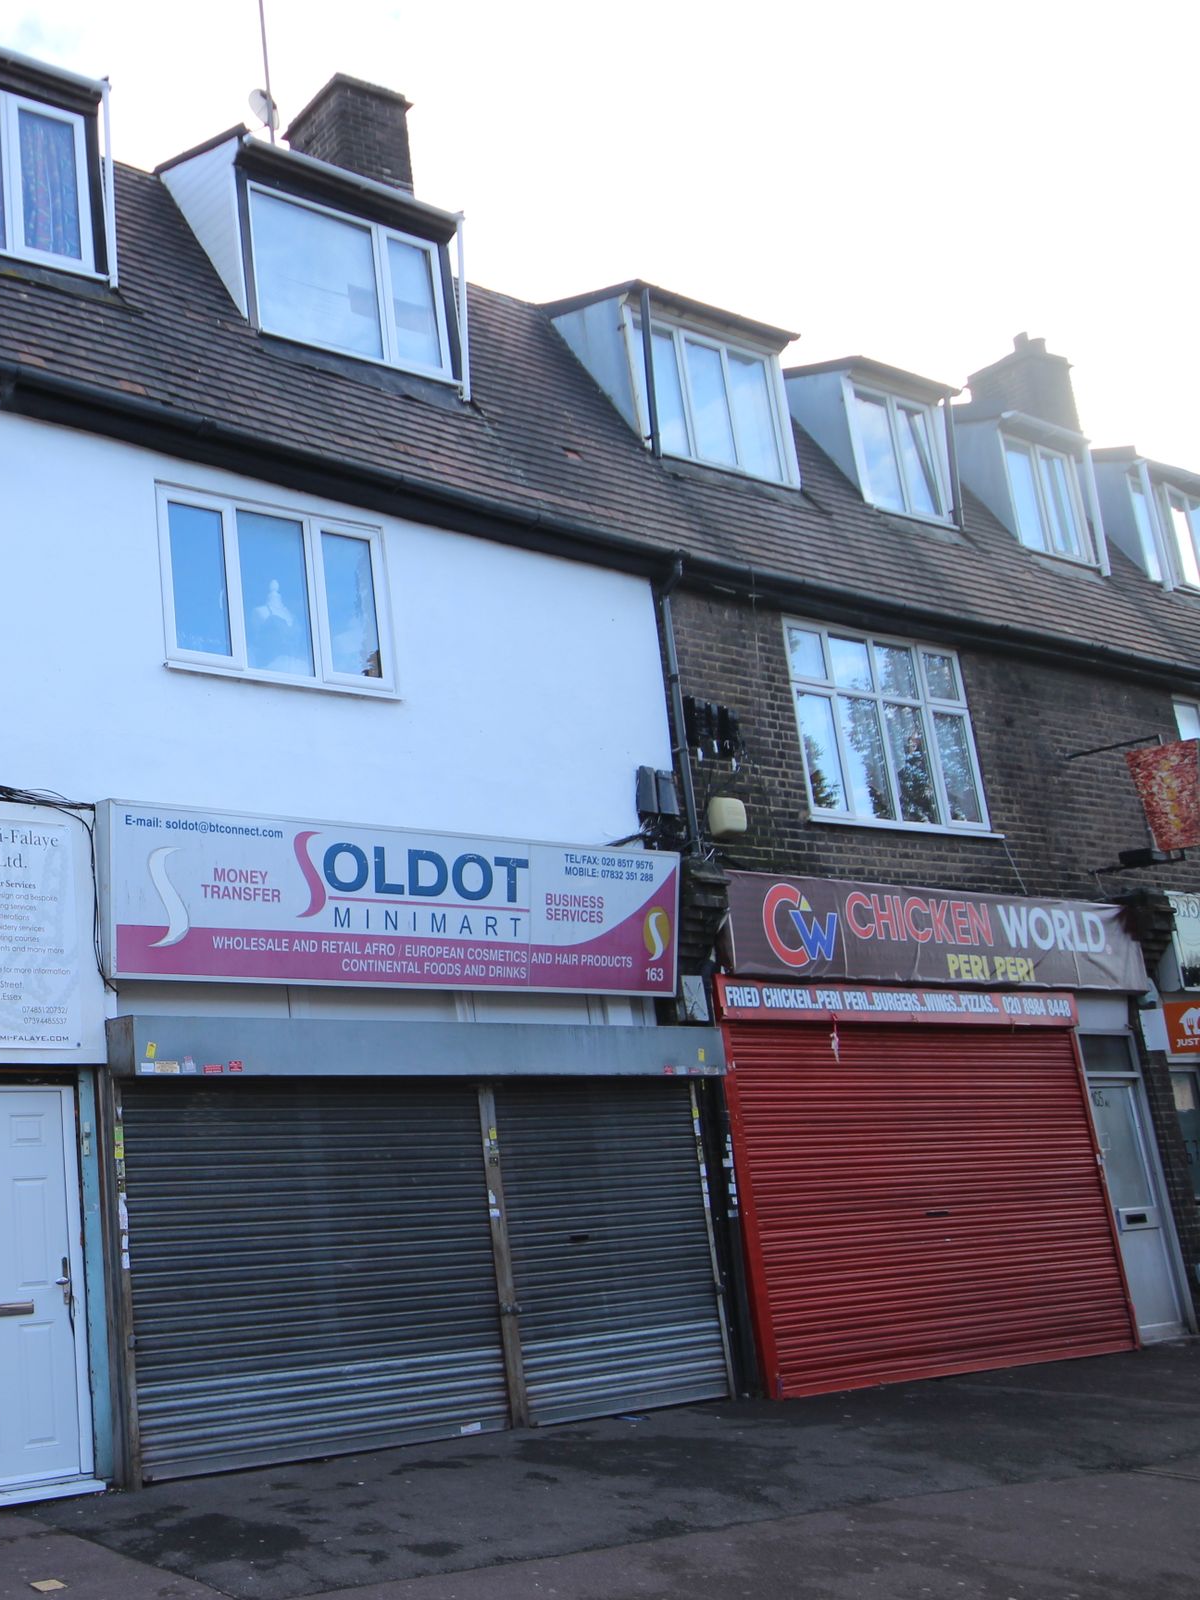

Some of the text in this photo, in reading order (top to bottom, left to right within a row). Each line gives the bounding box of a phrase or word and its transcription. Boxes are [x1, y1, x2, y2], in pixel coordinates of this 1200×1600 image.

[125, 814, 284, 839] E-mail: soldot@btconnect.com
[564, 853, 654, 871] TEL/FAX: 020 8517 9576
[213, 867, 269, 885] MONEY
[293, 830, 530, 918] SOLDOT
[564, 866, 654, 882] MOBILE: 07832 351 288
[5, 879, 36, 890] Services
[200, 884, 282, 903] TRANSFER
[545, 893, 605, 909] BUSINESS
[334, 906, 522, 938] MINIMART
[545, 908, 604, 924] SERVICES
[845, 891, 1106, 953] CHICKEN WORLD
[211, 935, 289, 952] WHOLESALE
[292, 939, 318, 953] AND
[321, 940, 361, 955] RETAIL
[363, 942, 396, 957] AFRO
[404, 944, 465, 959] EUROPEAN
[466, 947, 528, 964] COSMETICS
[530, 951, 553, 965] AND
[555, 953, 579, 966] HAIR
[580, 954, 633, 969] PRODUCTS
[341, 958, 527, 979] CONTINENTAL FOODS AND DRINKS
[645, 967, 664, 982] 163
[946, 953, 1037, 983] PERI PERI
[724, 986, 761, 1008] FRIED
[1001, 996, 1023, 1014] 020
[1023, 997, 1047, 1016] 8984
[1047, 999, 1072, 1017] 8448
